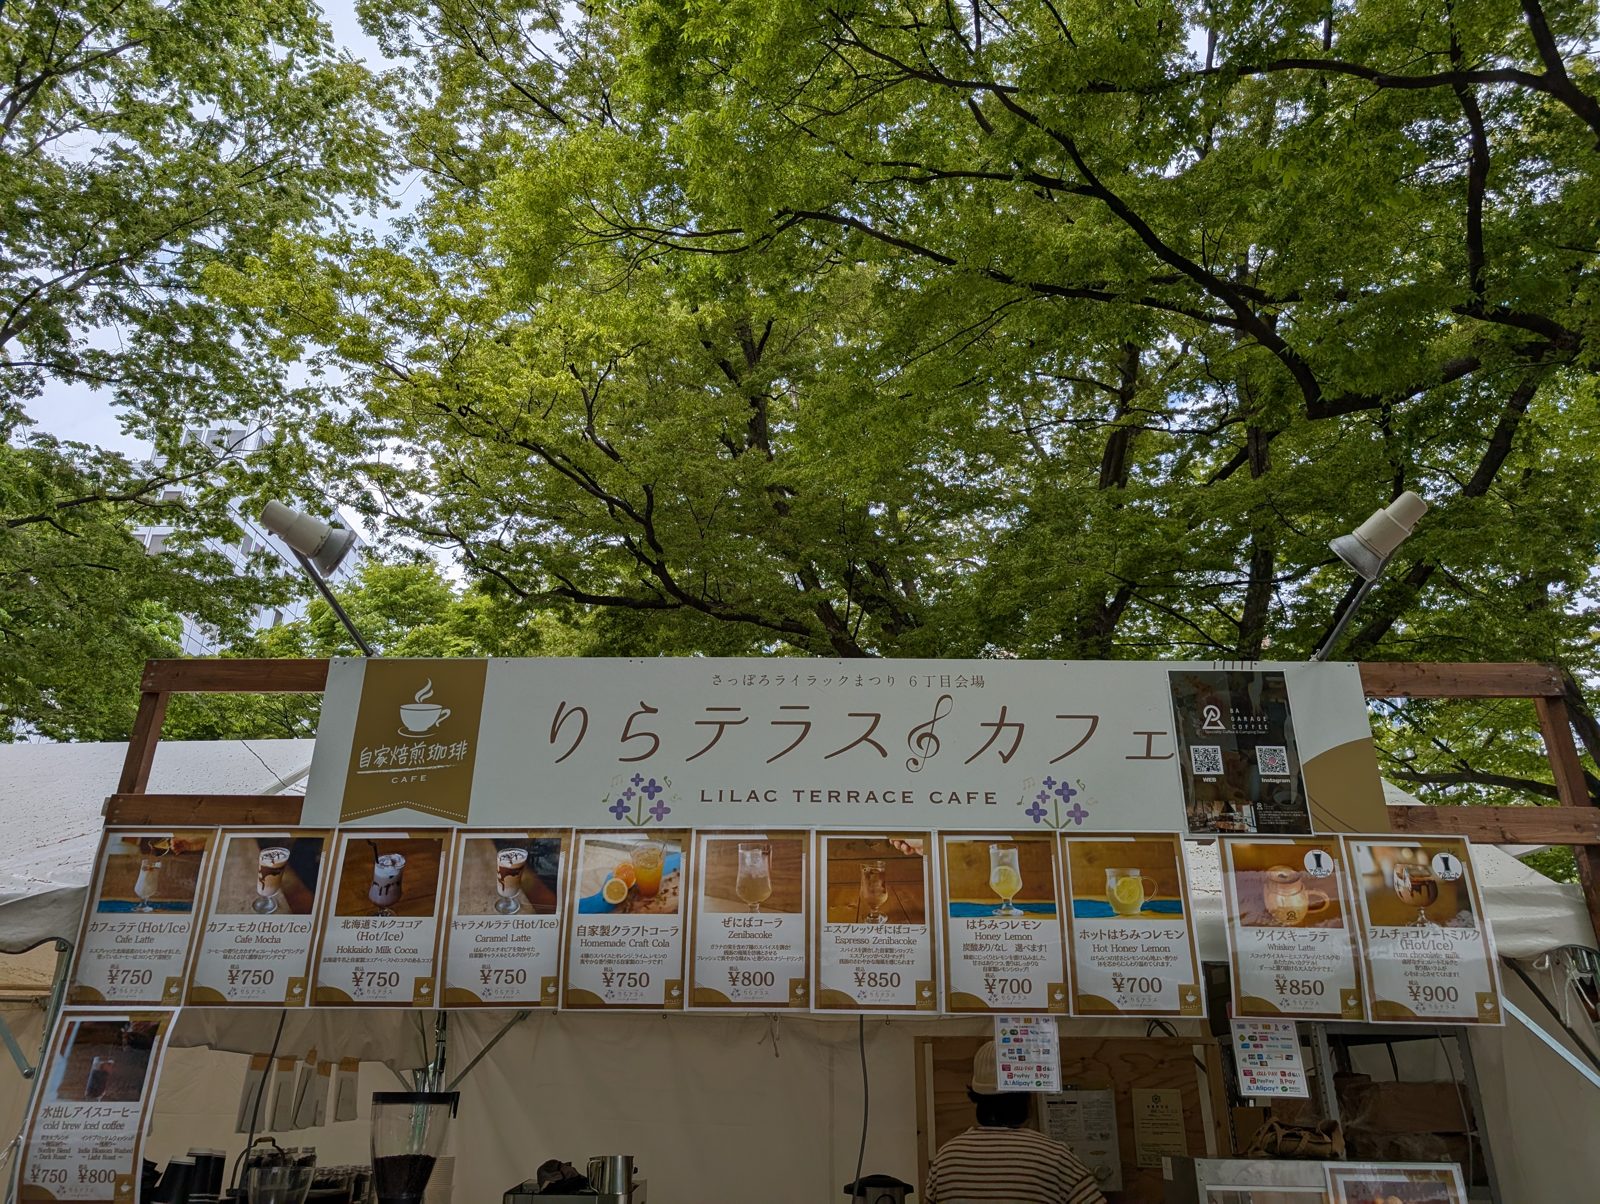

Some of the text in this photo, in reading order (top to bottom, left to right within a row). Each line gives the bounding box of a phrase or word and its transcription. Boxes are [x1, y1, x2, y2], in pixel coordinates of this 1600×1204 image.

[711, 673, 985, 689] さっぽろライラックまつり 6丁目会場
[550, 700, 1174, 764] りらテラス カフェ
[359, 740, 468, 769] 自家焙煎珈琲
[391, 774, 428, 785] CAFE
[700, 789, 997, 805] LILAC TERRACE CAFE
[341, 919, 423, 930] 北海道ミルクココア
[721, 917, 783, 929] ぜにばコーラ
[966, 919, 1042, 930] はちみつレモン
[356, 931, 404, 942] (Hot/Ice)
[576, 925, 679, 937] 自家製クラフトコーラ
[728, 931, 773, 940] Zenibacoke
[823, 925, 928, 936] エスプレッソぜにばコーラ
[974, 932, 1033, 942] Honey Lemon
[1079, 929, 1185, 940] ホットはちみつレモン
[1255, 930, 1330, 943] ウイスキーラテ
[1368, 929, 1481, 942] ラムチョコレートミルク
[134, 935, 155, 944] Latte
[234, 935, 281, 944] Cafe Mocha
[475, 933, 532, 943] Caramel Latte
[580, 939, 670, 948] Homemade Craft Cola
[835, 936, 917, 946] Espresso Zenibacoke
[336, 945, 418, 954] Hokkaido Milk Cocoa
[1092, 944, 1171, 954] Hot Honey Lemon
[1267, 943, 1316, 952] Whiskey Latte
[107, 969, 152, 985] ¥750
[227, 969, 274, 985] ¥750
[351, 971, 400, 987] ¥750
[480, 969, 527, 985] ¥750
[602, 972, 650, 988] ¥750
[728, 971, 775, 987] ¥800
[853, 972, 901, 988] ¥850
[984, 978, 1033, 994] ¥700
[1112, 977, 1163, 993] ¥700
[1275, 979, 1325, 996] ¥850
[1407, 986, 1459, 1003] ¥900
[40, 1106, 140, 1119] 水出しアイスコーヒー
[43, 1120, 125, 1130] cold brew iced coffee
[30, 1168, 68, 1184] ¥750
[78, 1168, 117, 1184] ¥800
